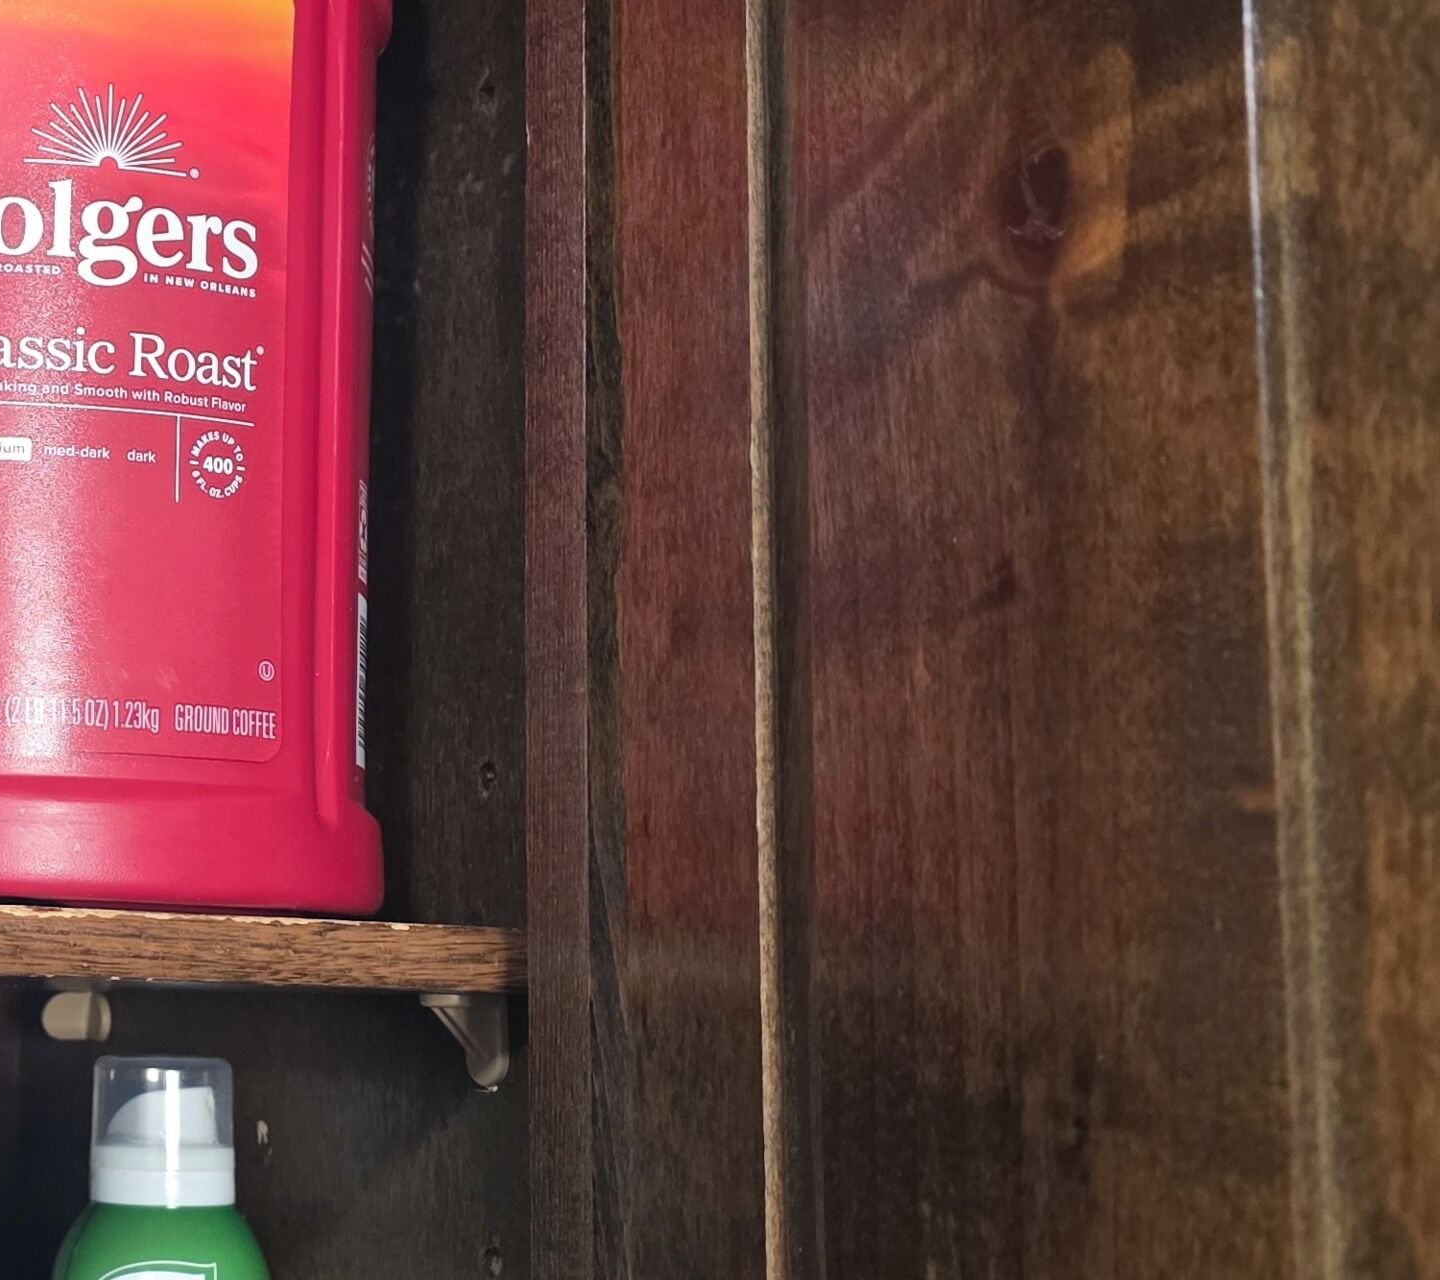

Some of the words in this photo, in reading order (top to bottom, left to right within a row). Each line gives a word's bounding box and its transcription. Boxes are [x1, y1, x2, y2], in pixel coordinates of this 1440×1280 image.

[144, 272, 158, 284] IN
[164, 274, 194, 290] NEW
[200, 280, 258, 298] ORLEANS
[128, 332, 258, 392] Roast
[42, 383, 69, 395] and
[74, 384, 128, 400] Smooth
[132, 386, 160, 403] with
[164, 390, 208, 408] Robust
[211, 397, 246, 414] Flavor
[44, 444, 110, 460] med-dark
[126, 448, 156, 464] dark
[190, 430, 220, 457] MAKES
[222, 432, 235, 445] UP
[233, 445, 244, 462] TO
[202, 456, 234, 475] 400
[224, 474, 243, 496] CUPS
[84, 698, 109, 730] OZ)
[112, 700, 160, 734] 1.23kg
[174, 704, 229, 734] GROUND
[232, 708, 276, 740] COFFEE
